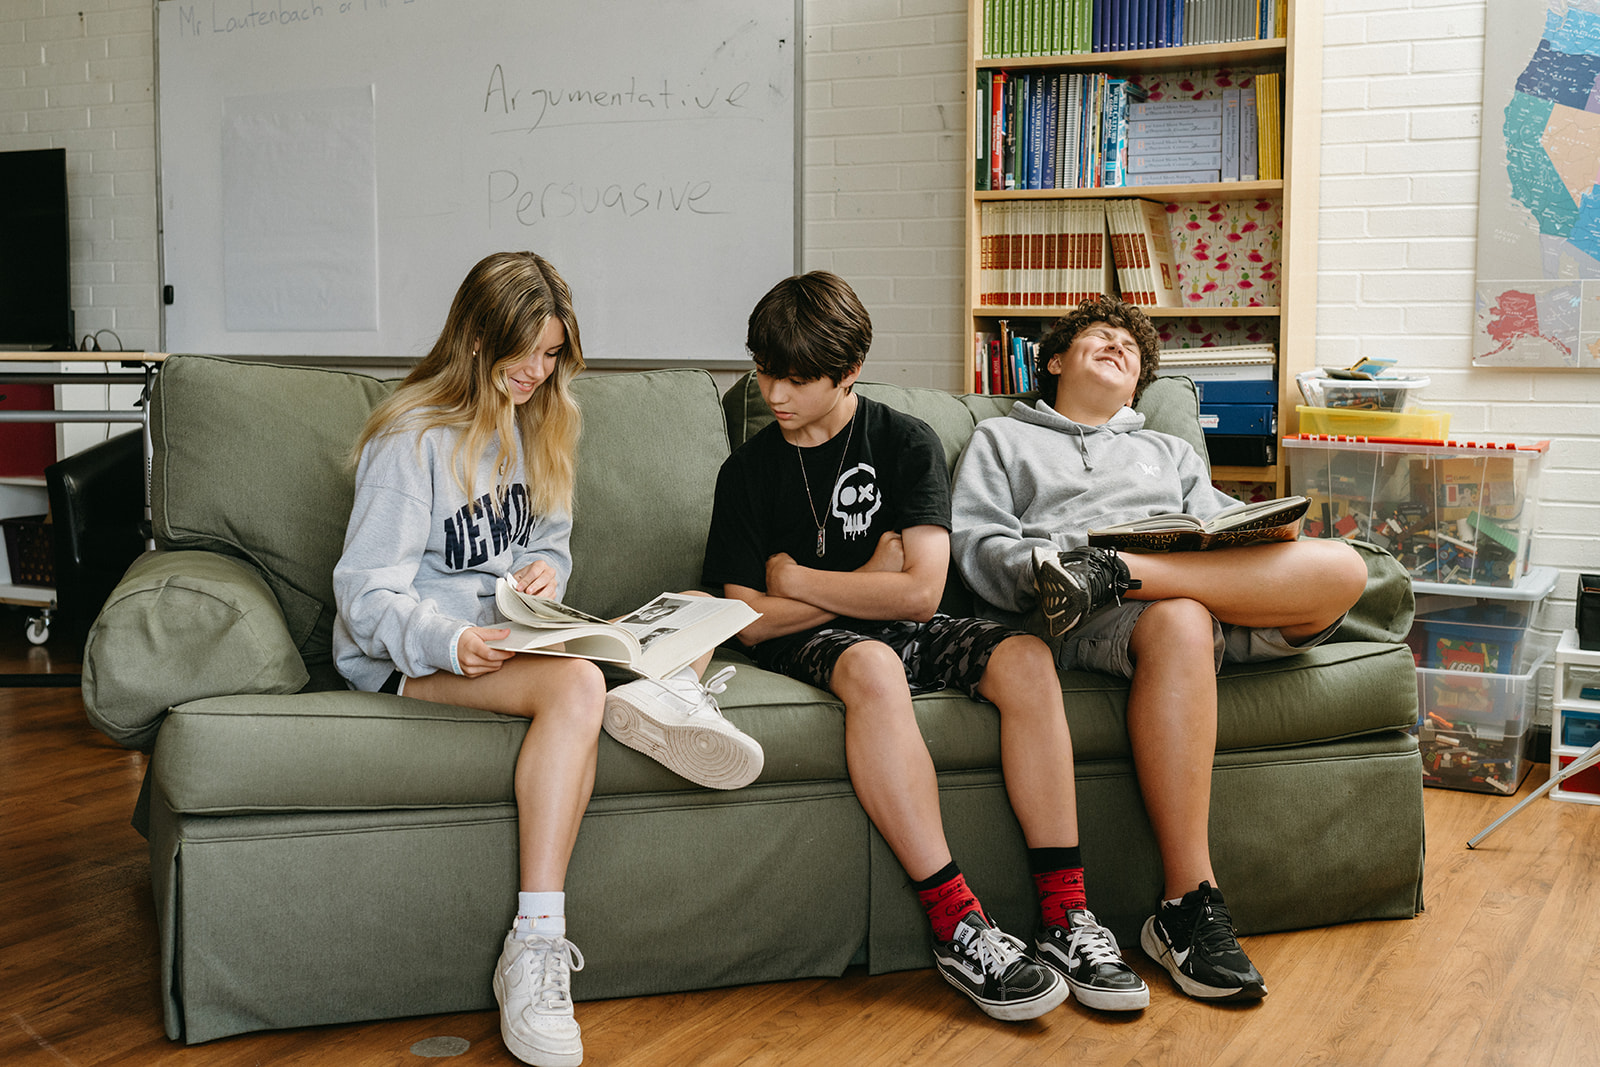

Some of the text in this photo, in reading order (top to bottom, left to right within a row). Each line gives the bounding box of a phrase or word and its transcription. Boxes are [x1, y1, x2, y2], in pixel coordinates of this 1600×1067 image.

[179, 5, 201, 37] Mr
[213, 0, 323, 33] Lautenbach
[484, 63, 750, 134] Argumentative
[488, 170, 732, 230] Persuasive
